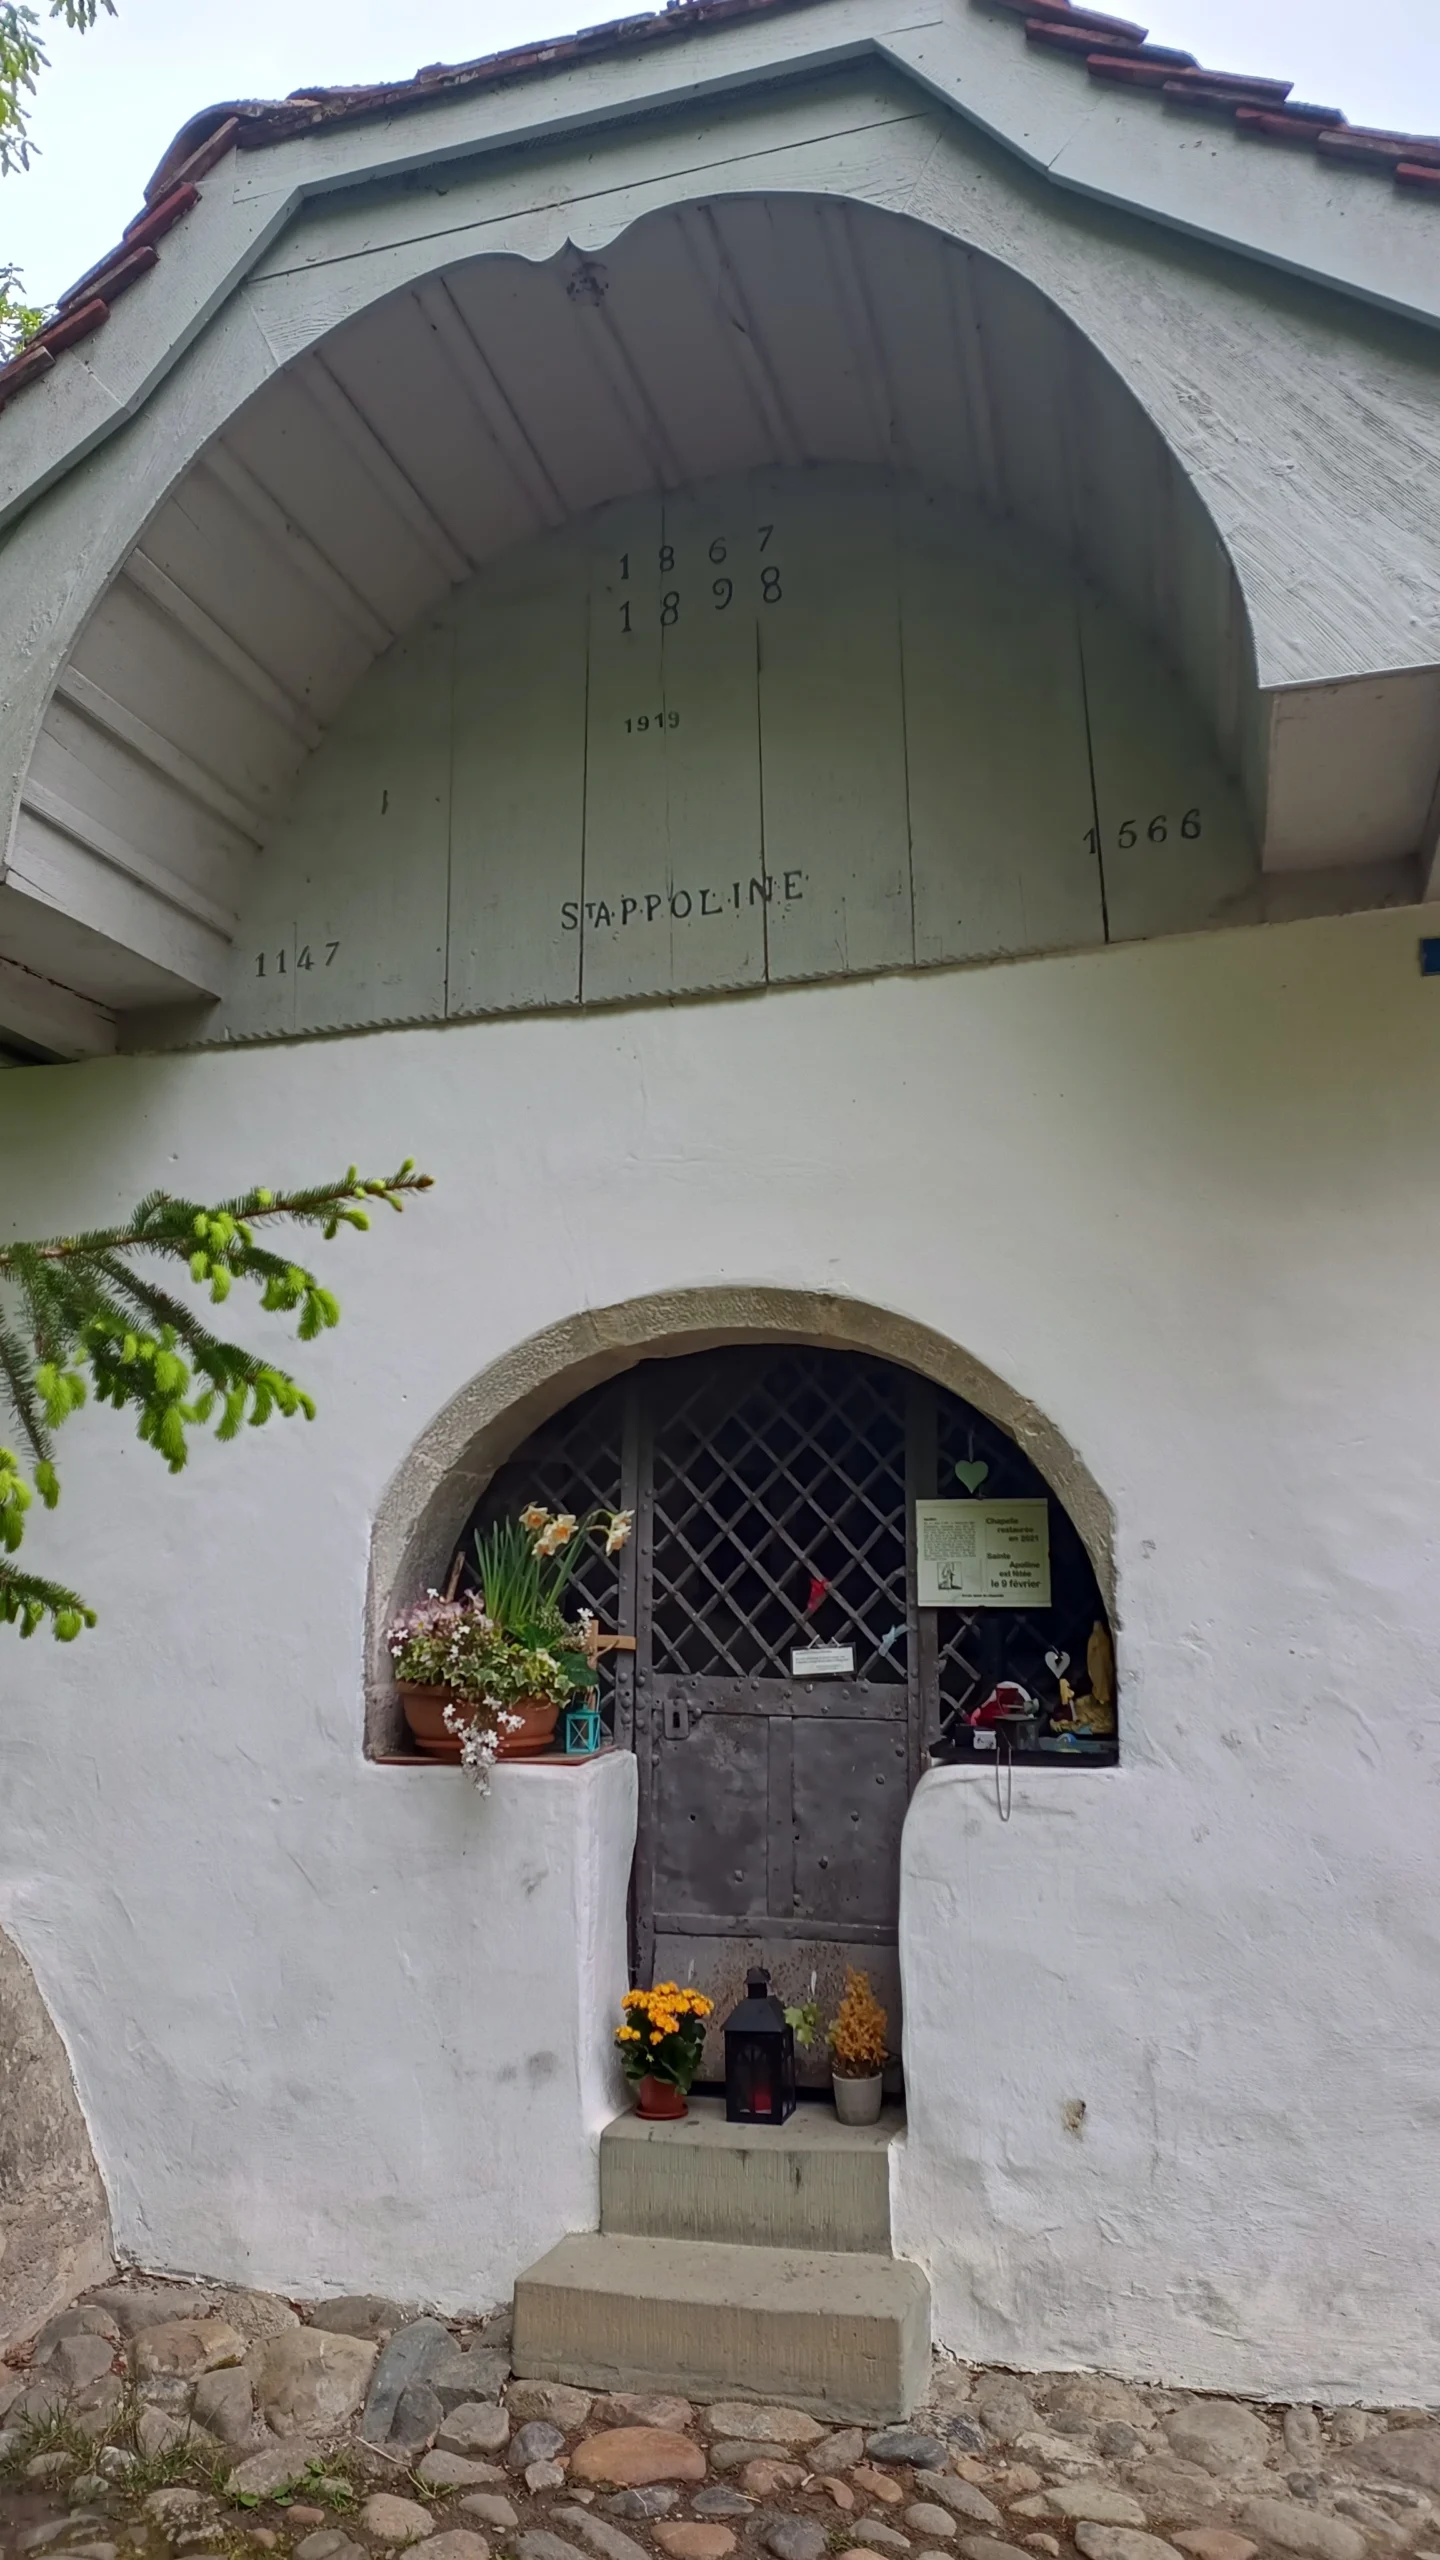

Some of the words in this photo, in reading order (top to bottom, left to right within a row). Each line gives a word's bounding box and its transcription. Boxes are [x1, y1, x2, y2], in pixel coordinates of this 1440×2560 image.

[619, 524, 774, 580] 1867
[619, 566, 782, 633] 1898
[624, 710, 680, 734] 1919
[1083, 808, 1201, 854] 1566
[255, 941, 341, 978] 1147
[985, 1517, 1019, 1526] Chapelle
[986, 1552, 1011, 1560] Sainte
[990, 1579, 1000, 1588] le
[1001, 1579, 1008, 1588] 9
[1009, 1579, 1041, 1588] février
